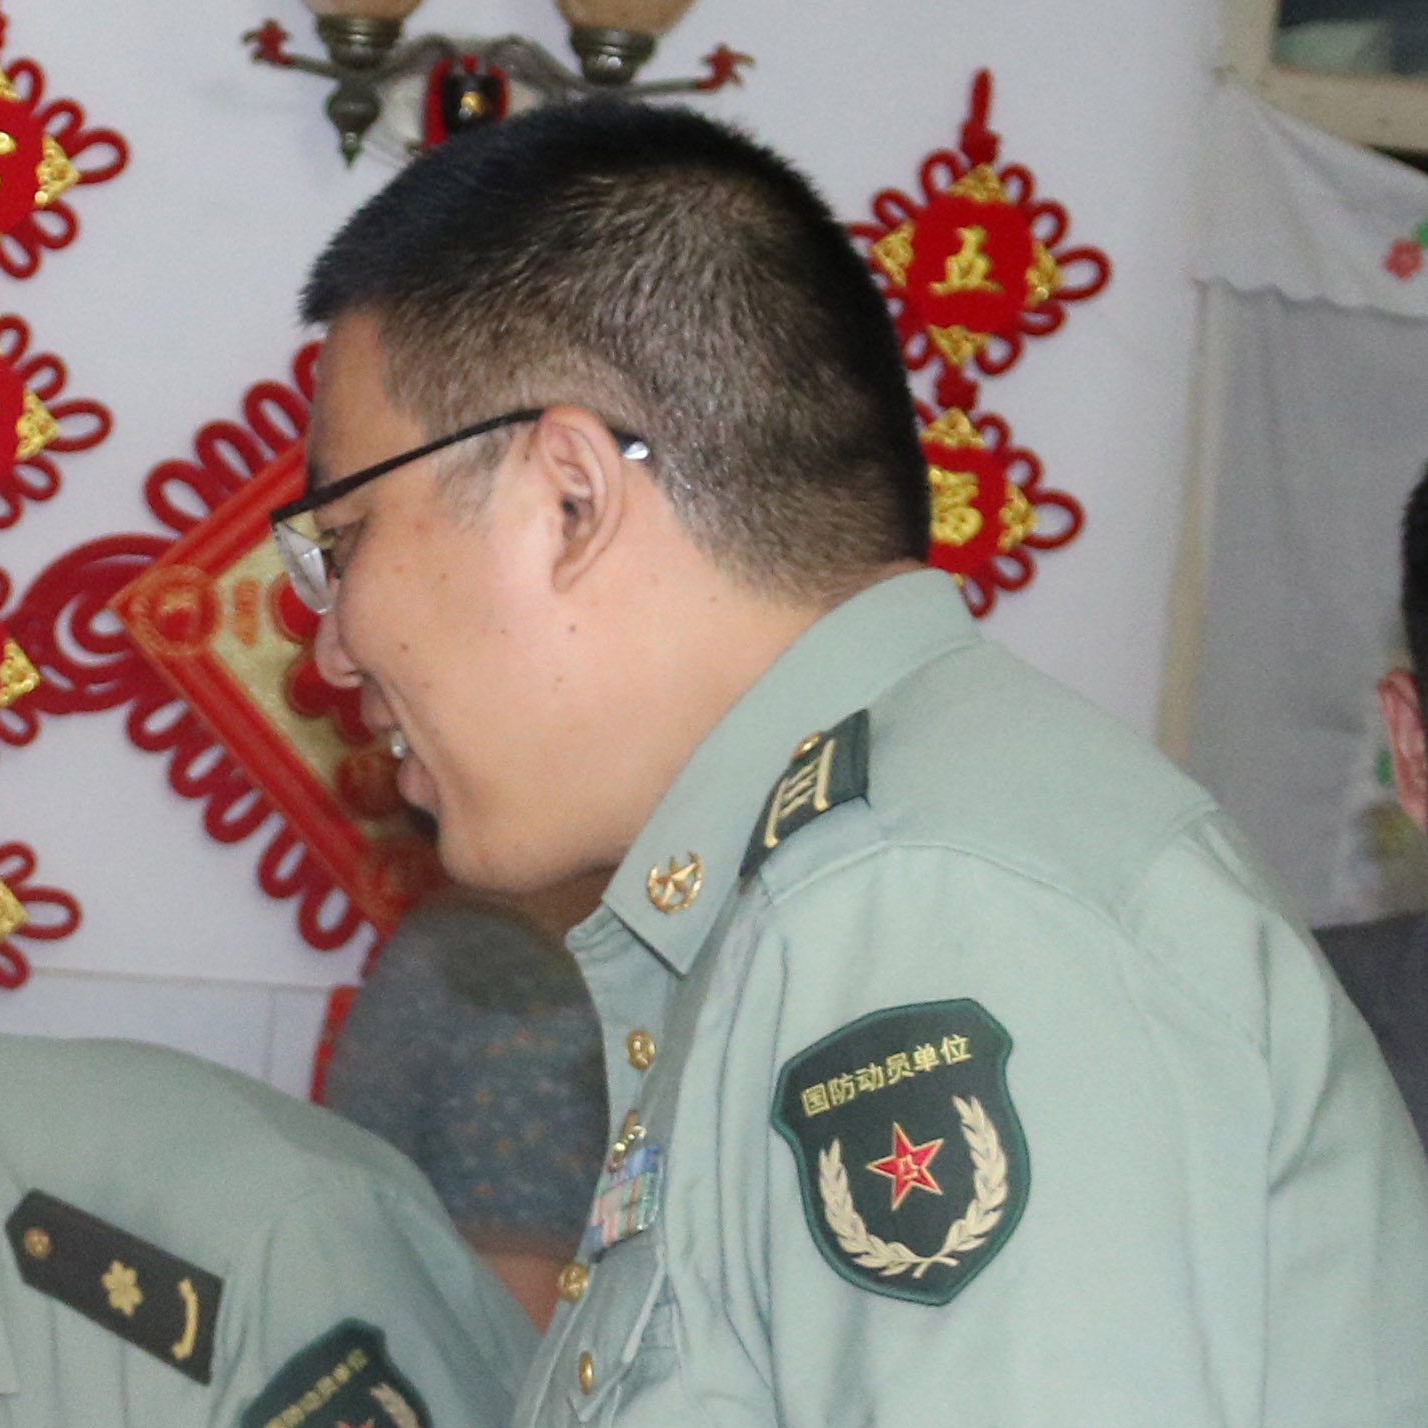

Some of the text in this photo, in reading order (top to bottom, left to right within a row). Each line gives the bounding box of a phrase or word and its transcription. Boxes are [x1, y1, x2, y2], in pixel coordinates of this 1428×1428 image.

[800, 1034, 973, 1118] 国防动员单位
